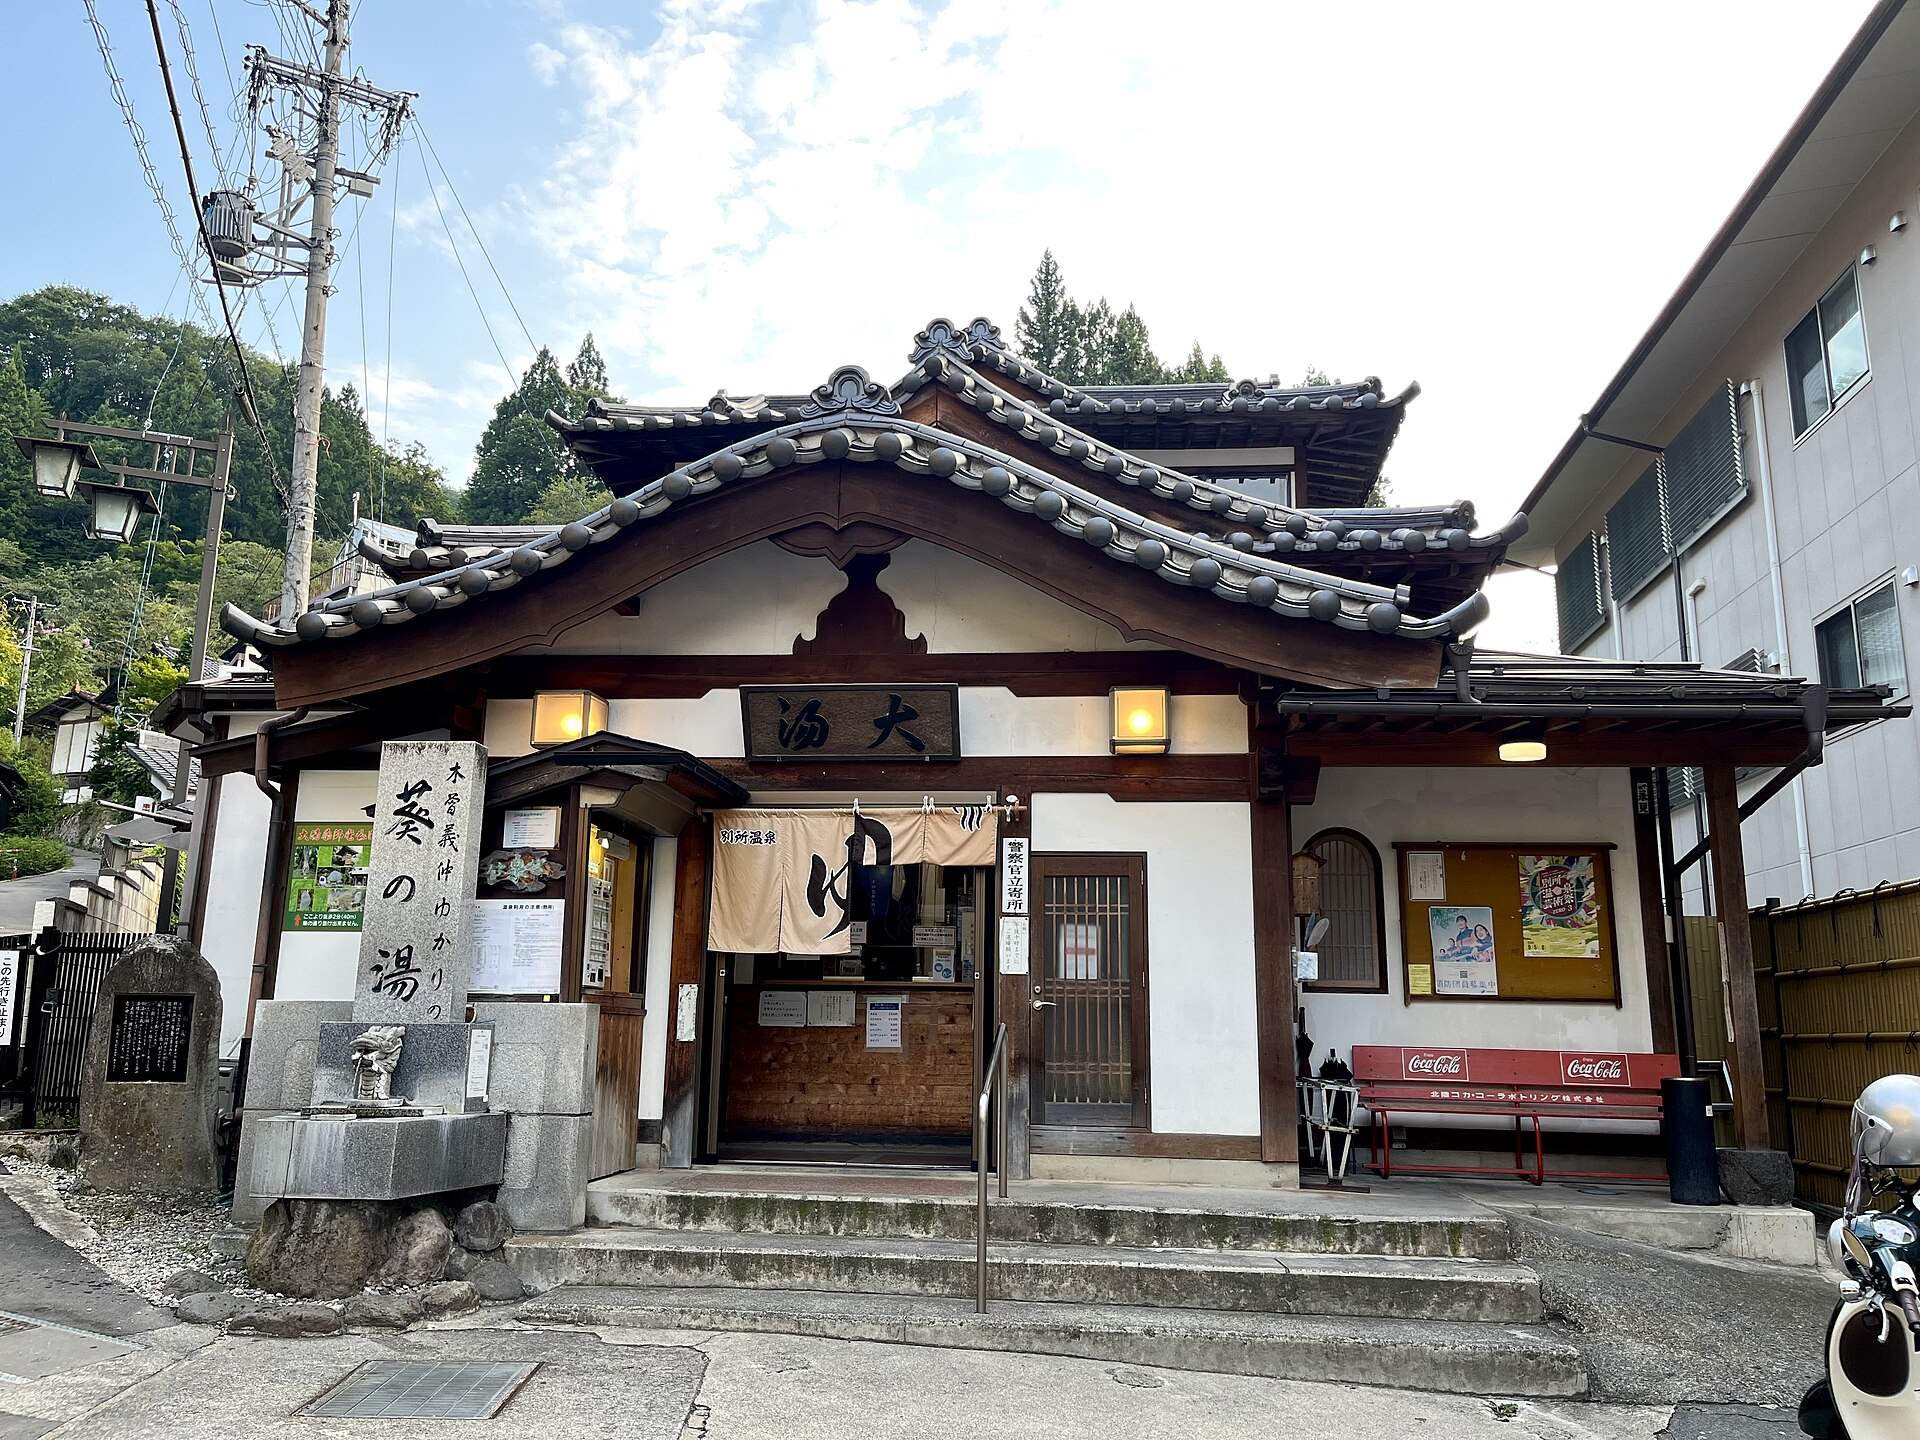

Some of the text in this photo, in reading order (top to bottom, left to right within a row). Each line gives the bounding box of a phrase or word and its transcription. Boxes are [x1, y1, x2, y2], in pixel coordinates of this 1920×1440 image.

[720, 829, 776, 845] 別所温泉
[1006, 841, 1024, 911] 警察官立寄所
[370, 779, 435, 1001] 葵の湯
[1408, 1055, 1462, 1074] Coca-Cola
[1567, 1059, 1622, 1078] Coca-Cola
